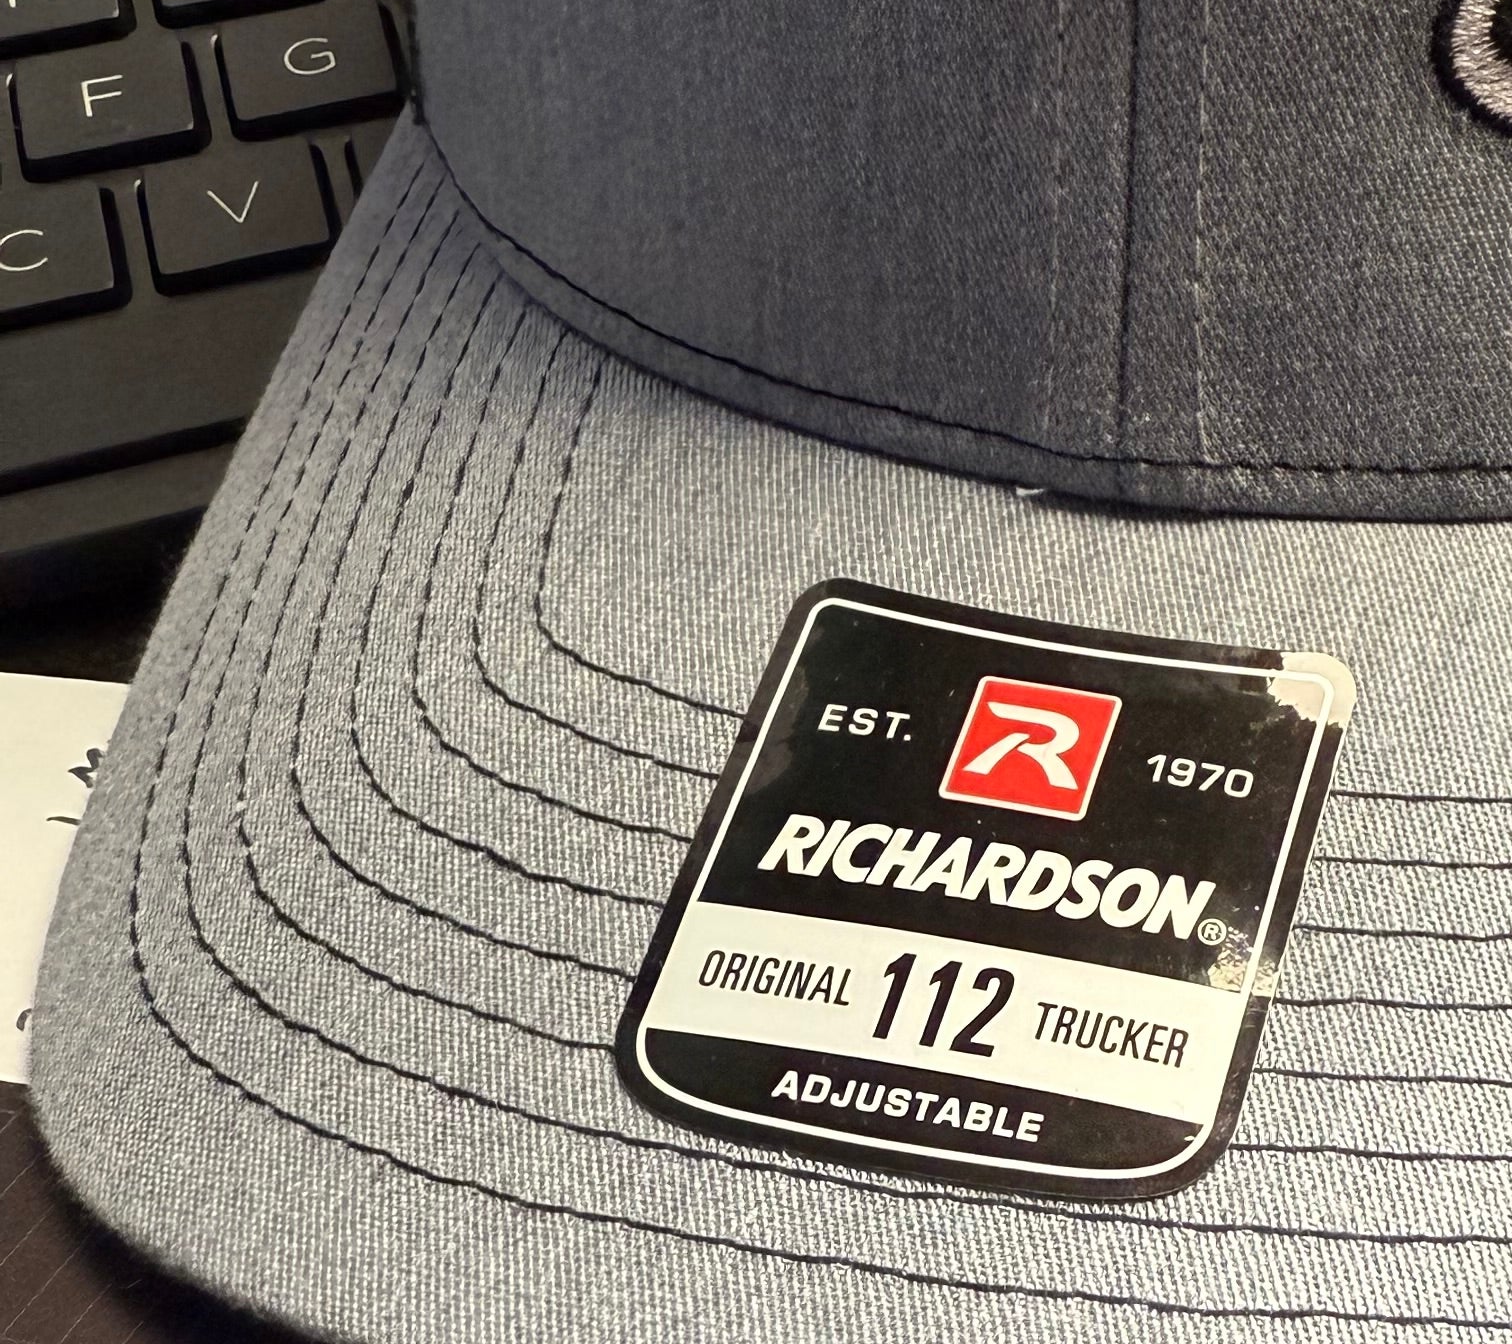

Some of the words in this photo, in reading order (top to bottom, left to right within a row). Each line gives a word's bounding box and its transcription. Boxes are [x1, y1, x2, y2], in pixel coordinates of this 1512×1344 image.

[284, 38, 336, 74] G
[81, 75, 122, 117] F
[207, 180, 259, 223] V
[0, 229, 48, 271] C
[818, 703, 912, 742] EST.
[1147, 754, 1254, 798] 1970
[698, 949, 852, 1007] ORIGINAL
[872, 952, 1016, 1059] 112
[1034, 1001, 1189, 1069] TRUCKER
[771, 1069, 1044, 1144] ADJUSTABLE
